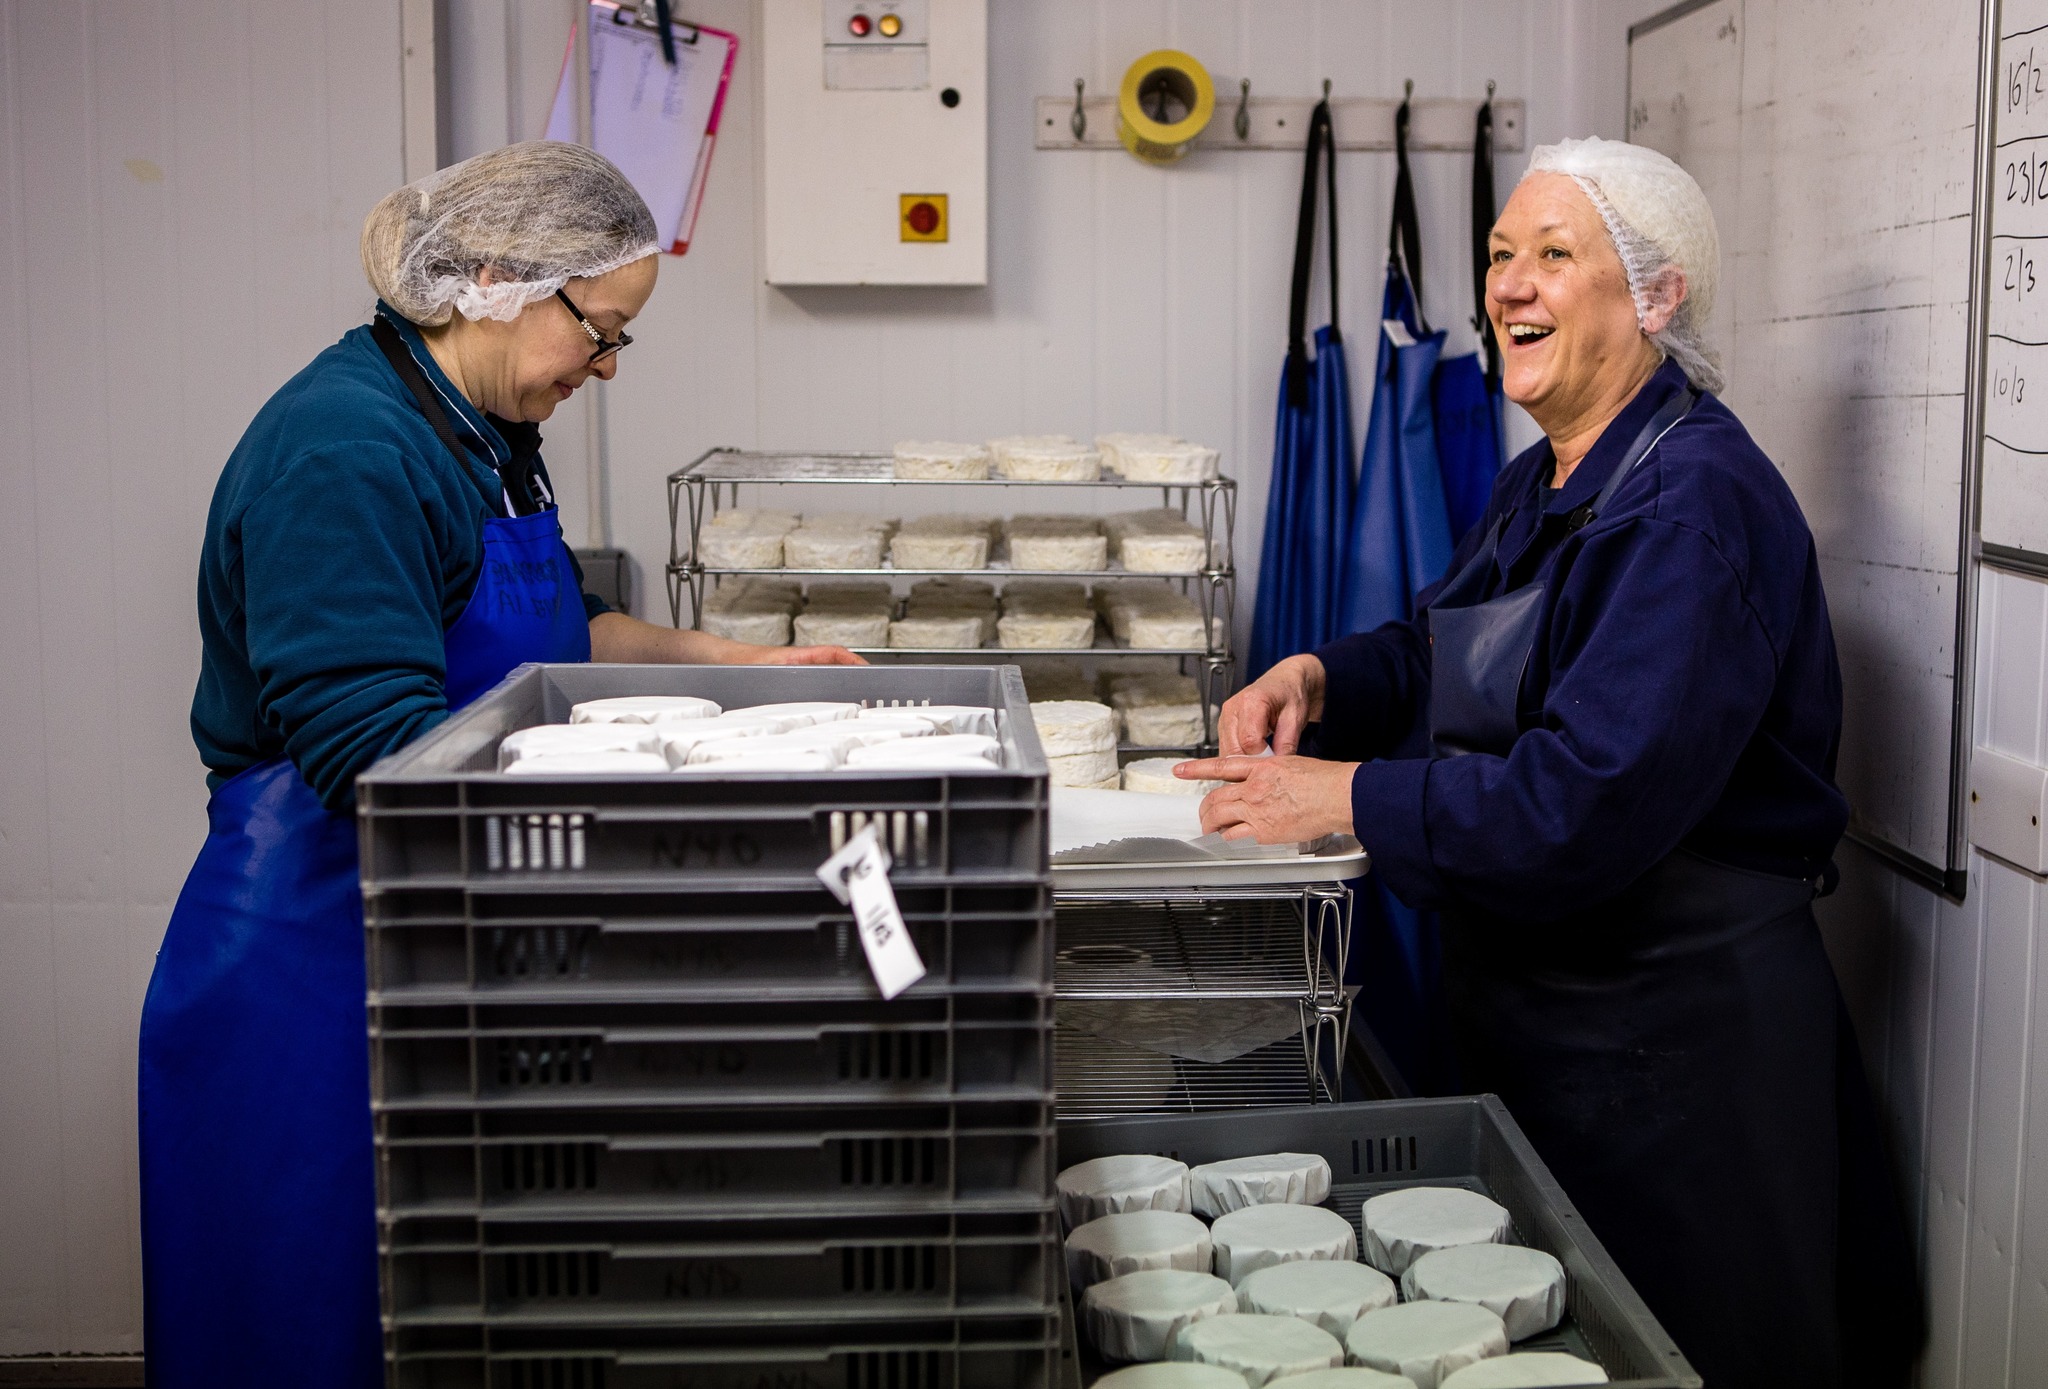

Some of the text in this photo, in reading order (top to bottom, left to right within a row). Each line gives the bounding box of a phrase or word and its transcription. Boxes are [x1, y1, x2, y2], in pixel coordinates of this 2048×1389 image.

[2008, 46, 2045, 115] 16/2
[2006, 151, 2048, 206] 23/2
[2004, 247, 2036, 302] 2/3
[1993, 365, 2025, 406] 10/3
